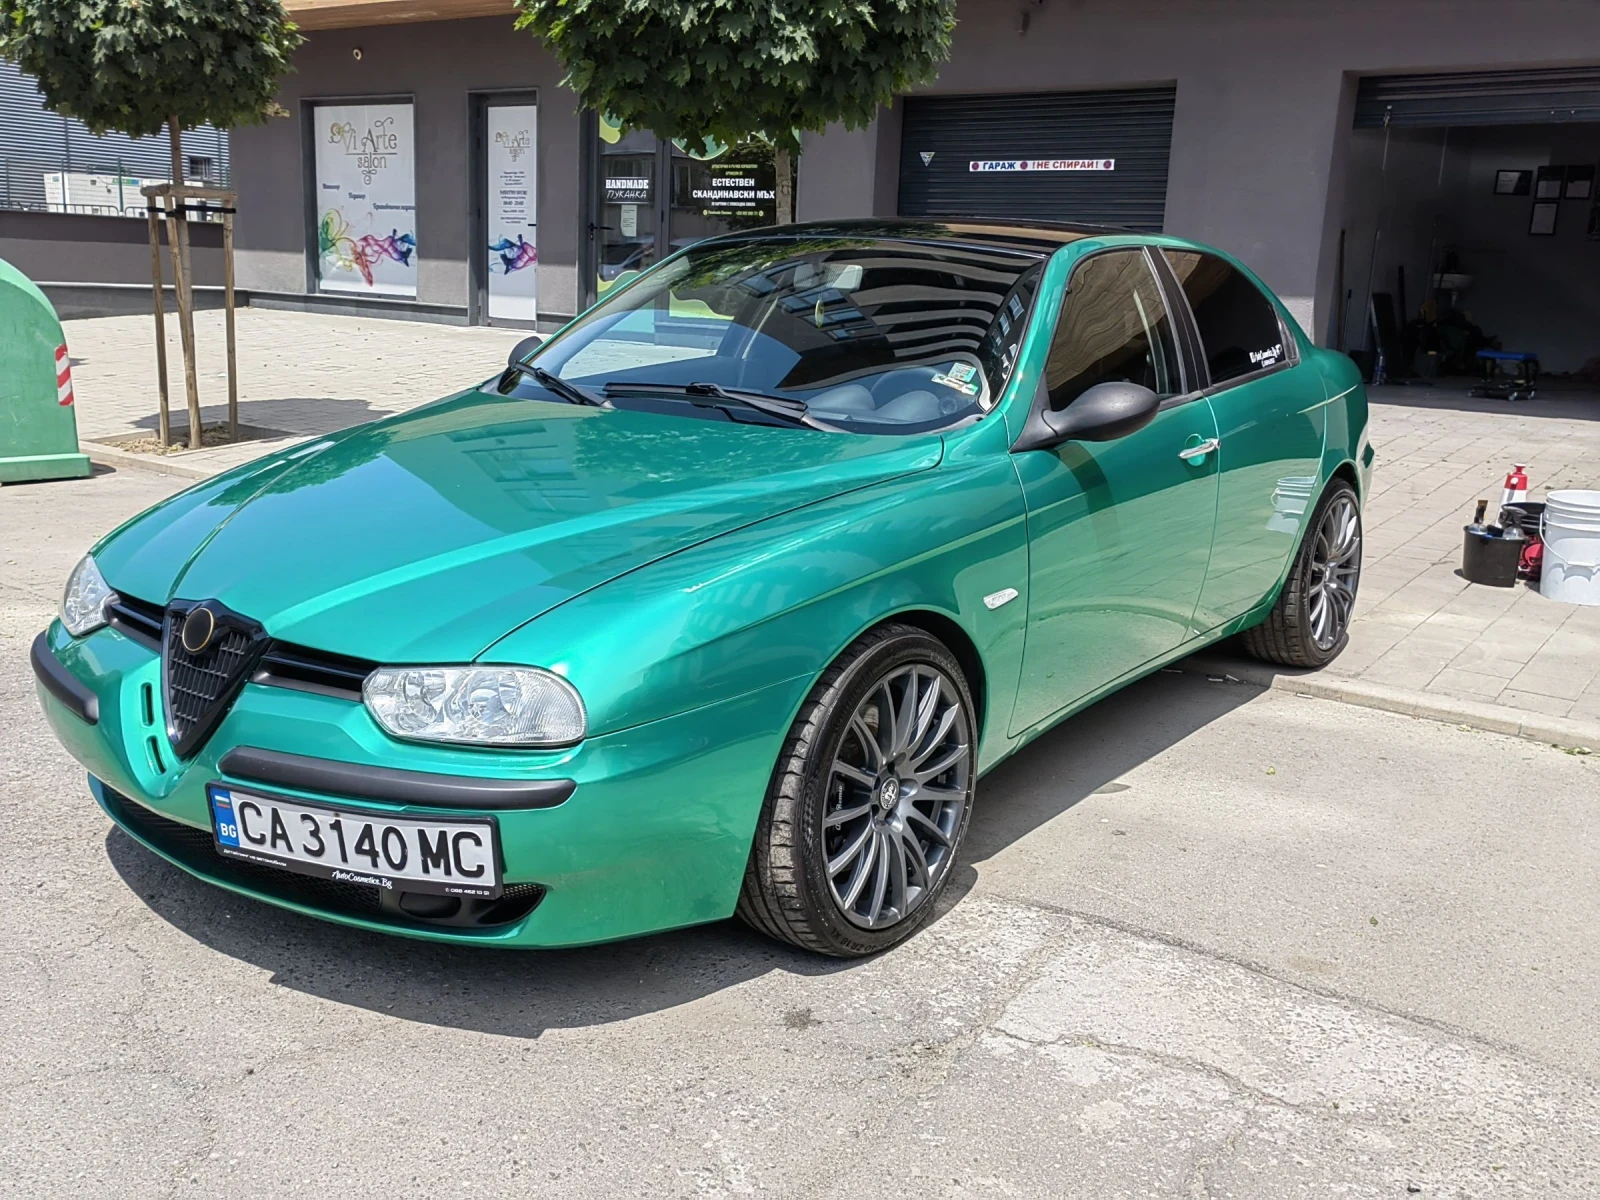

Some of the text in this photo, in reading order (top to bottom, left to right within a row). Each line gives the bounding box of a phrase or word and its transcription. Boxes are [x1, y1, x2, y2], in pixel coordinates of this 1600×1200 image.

[361, 117, 397, 152] Arte
[357, 152, 387, 173] salon
[982, 162, 1016, 170] ГАРАЖ
[605, 179, 649, 189] HANDMADE
[712, 178, 755, 187] ЕСТЕСТВЕН
[606, 190, 647, 199] ПУКАНКА
[692, 190, 775, 199] СКАНДИНАВСКИ МЪХ
[220, 822, 237, 838] BG
[238, 800, 485, 879] CA 3140 MC
